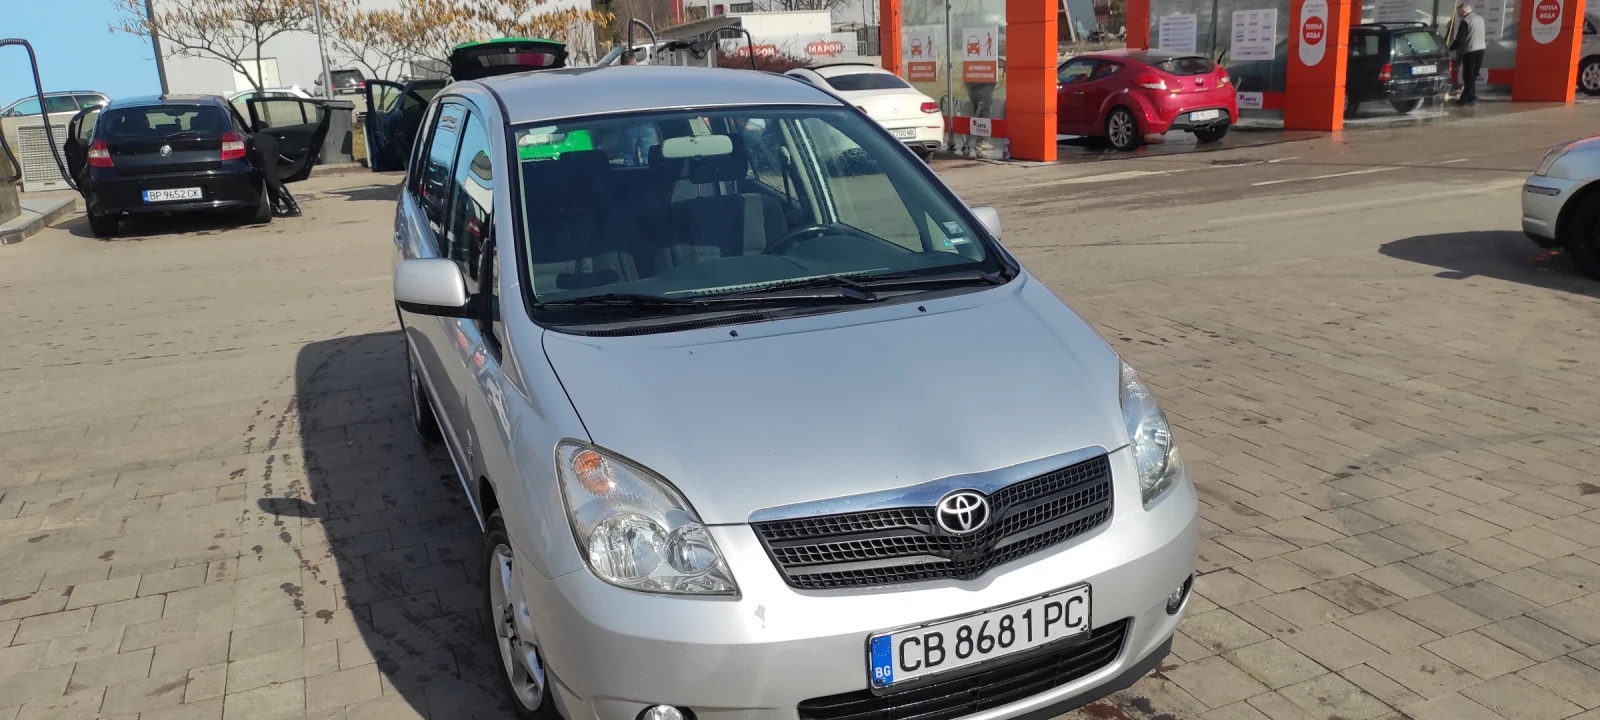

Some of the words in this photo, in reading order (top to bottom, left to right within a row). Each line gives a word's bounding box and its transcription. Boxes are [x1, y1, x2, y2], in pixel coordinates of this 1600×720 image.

[808, 43, 842, 54] МАРОН
[149, 191, 162, 200] BP
[163, 189, 186, 199] 9652
[187, 188, 200, 198] CK
[899, 631, 946, 672] CB
[955, 608, 1033, 659] 8681
[1043, 595, 1084, 638] PC
[875, 665, 891, 678] BG
